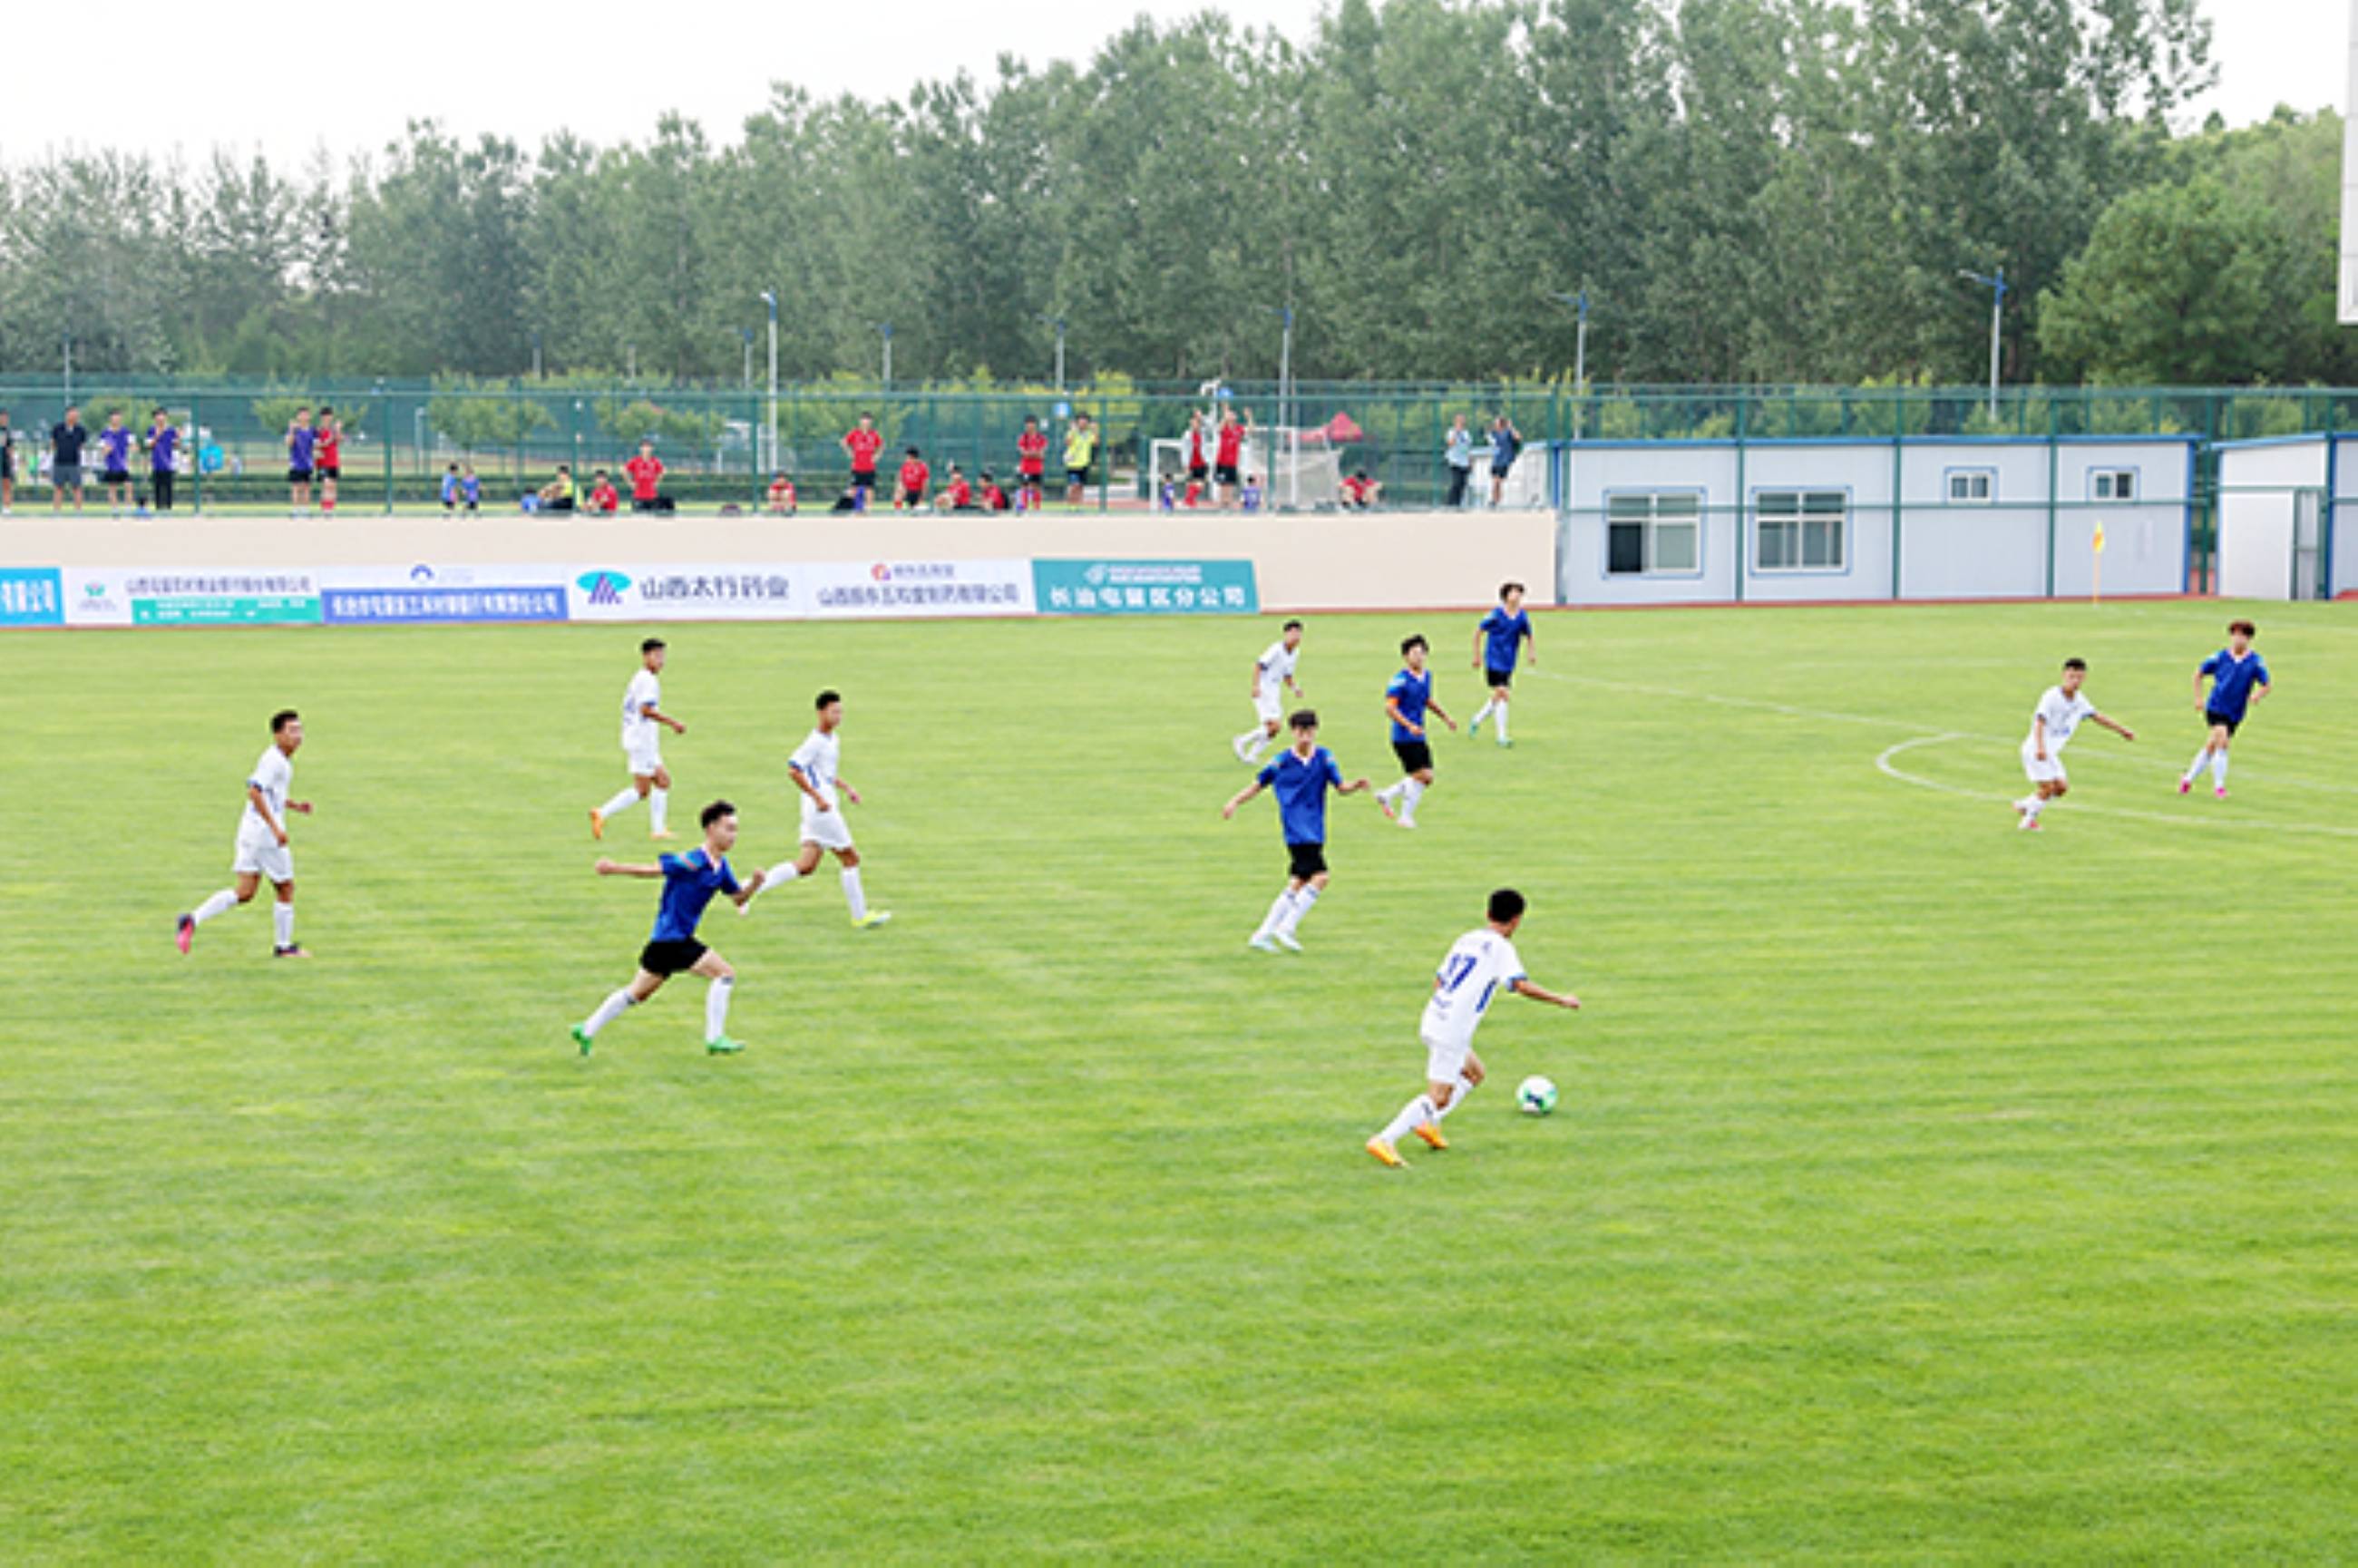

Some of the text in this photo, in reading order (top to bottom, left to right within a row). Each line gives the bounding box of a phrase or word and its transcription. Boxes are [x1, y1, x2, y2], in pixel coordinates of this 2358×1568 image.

[640, 575, 789, 599] 山西太行药业
